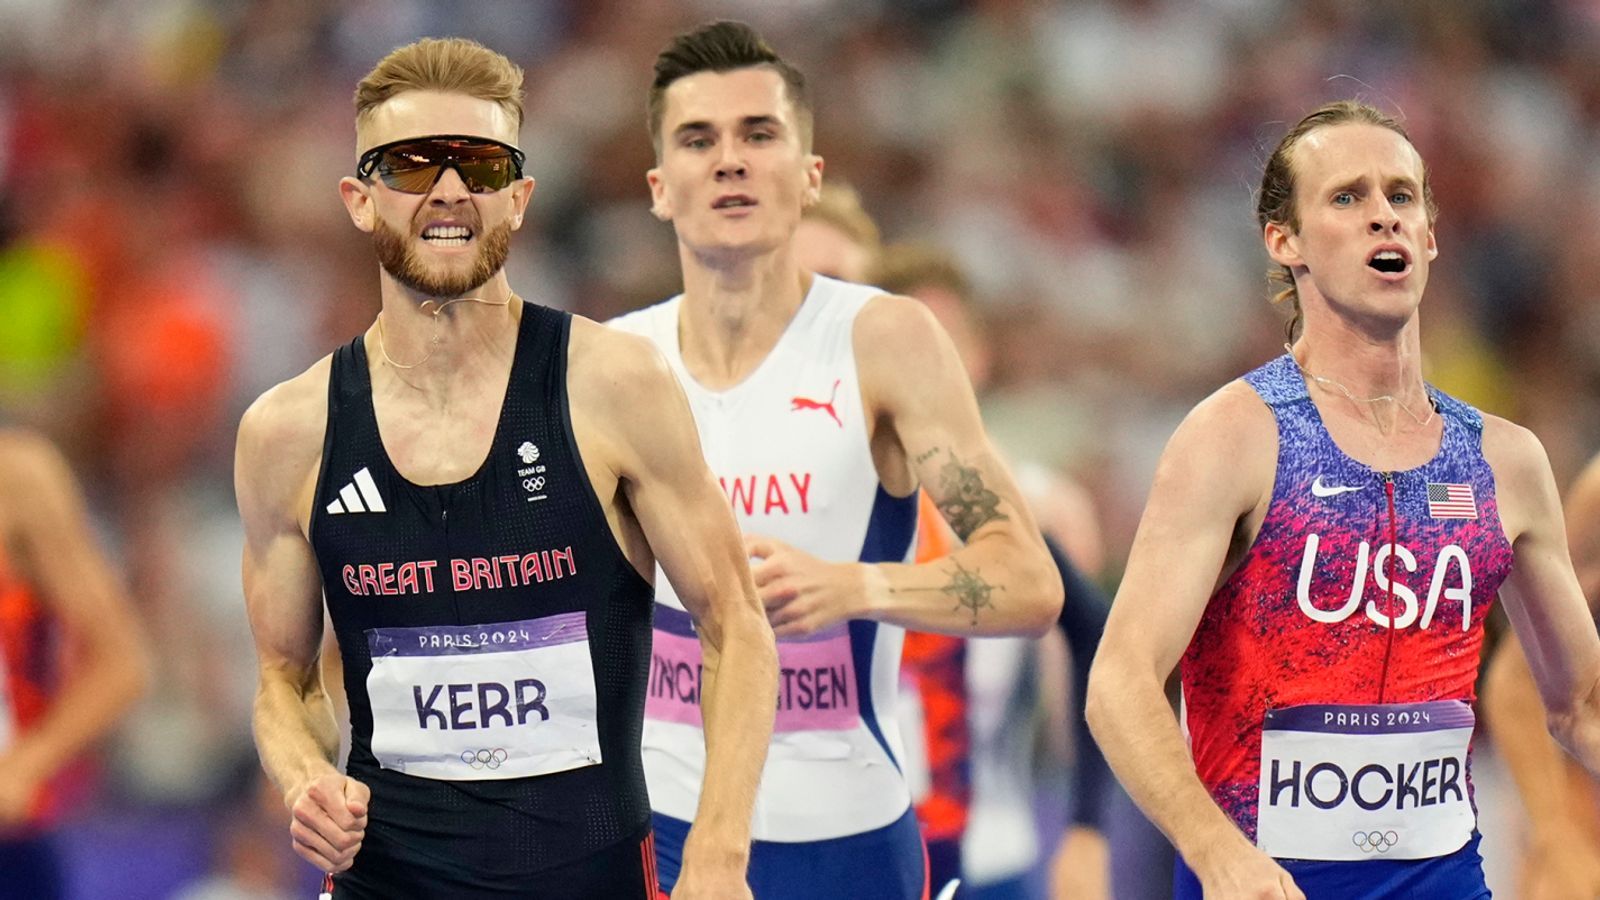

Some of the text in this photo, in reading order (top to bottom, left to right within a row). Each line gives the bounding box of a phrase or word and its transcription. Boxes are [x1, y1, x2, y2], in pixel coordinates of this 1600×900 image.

[518, 465, 546, 477] TEAM GB
[719, 473, 811, 516] WAY
[342, 546, 577, 596] GREAT BRITAIN
[1296, 533, 1472, 632] USA
[419, 630, 530, 648] PARIS 2024
[412, 678, 550, 730] KERR
[651, 654, 849, 710] INGTSEN
[1324, 711, 1430, 726] PARIS 2024
[1268, 756, 1463, 811] HOCKER
